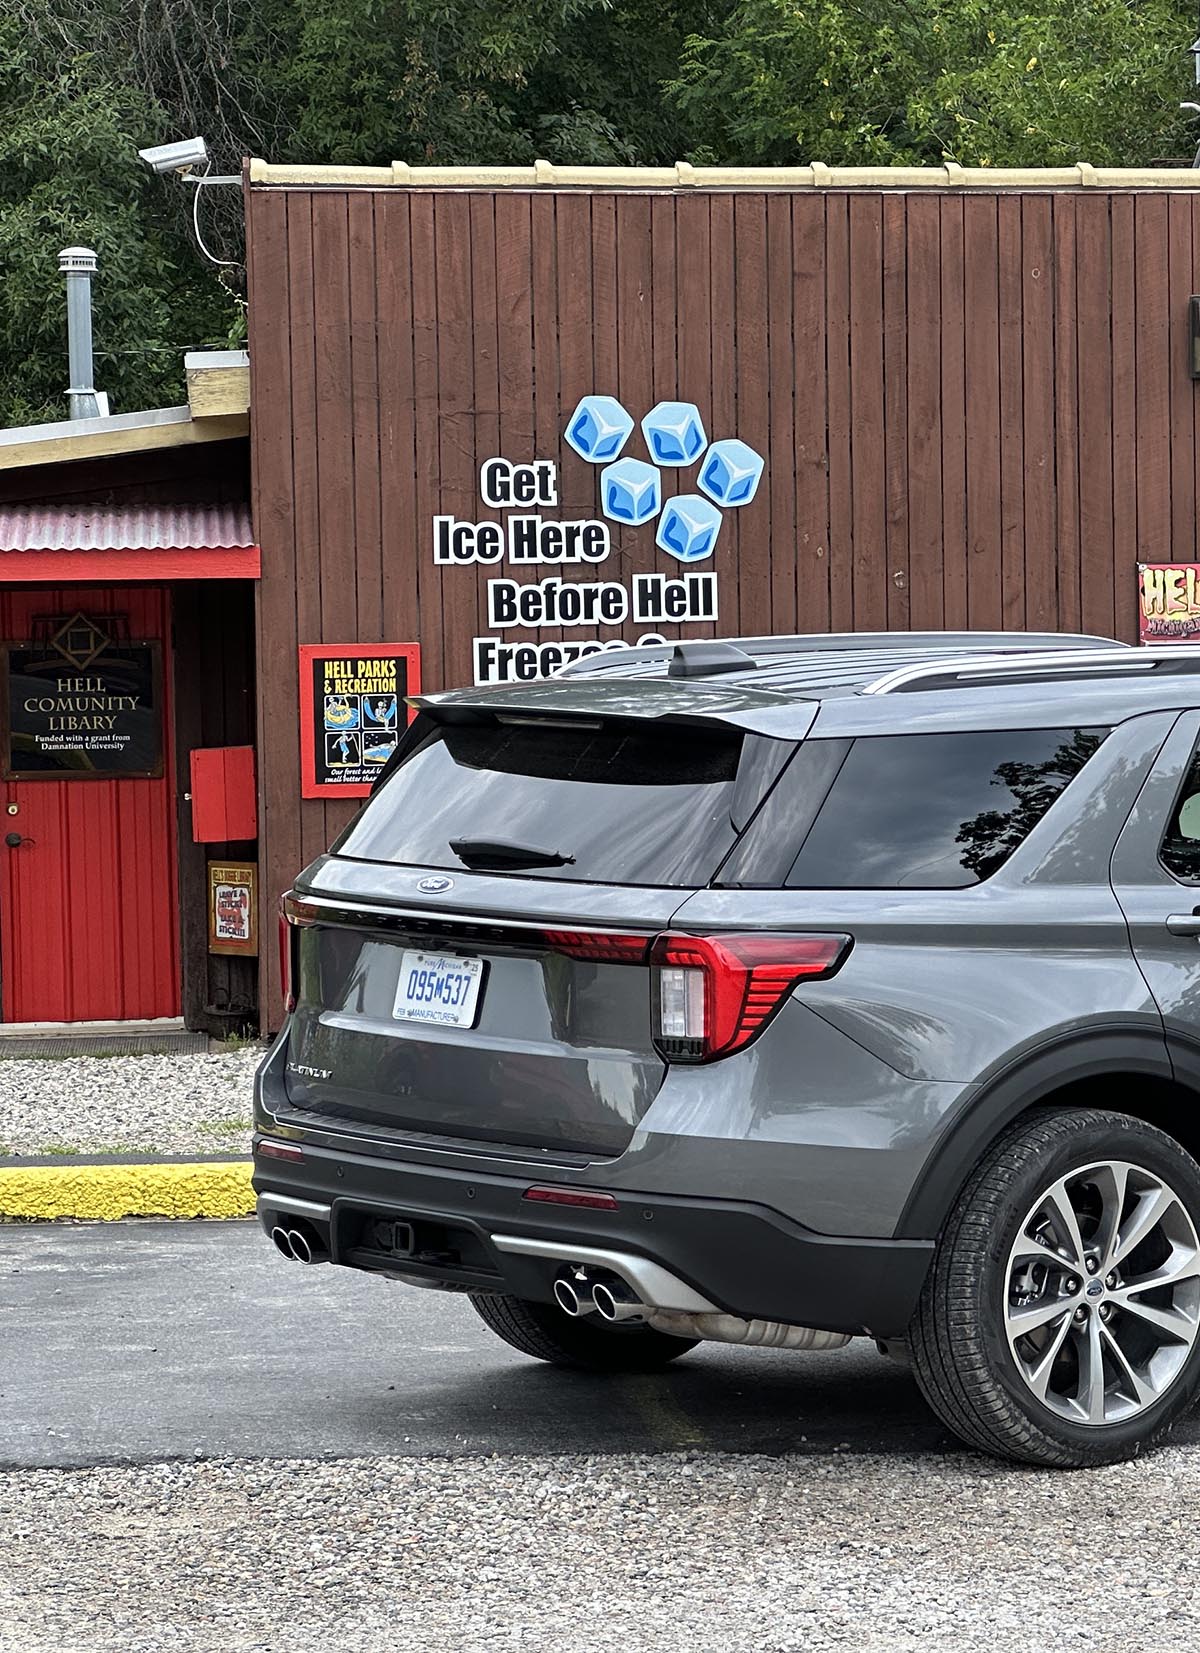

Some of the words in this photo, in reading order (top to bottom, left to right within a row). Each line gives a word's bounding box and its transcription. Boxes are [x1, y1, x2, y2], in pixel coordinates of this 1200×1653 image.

[485, 461, 552, 502] Get
[438, 520, 500, 559] Ice
[512, 518, 606, 559] Here
[492, 580, 624, 623] Before
[637, 577, 714, 618] Hell
[324, 661, 354, 679] HELL
[357, 660, 397, 678] PARKS
[57, 678, 106, 692] HELL
[323, 679, 332, 694] &
[335, 678, 397, 693] RECREATION
[24, 696, 140, 712] COMUNITY
[48, 715, 117, 731] LIBARY
[35, 735, 64, 743] Funded
[90, 735, 111, 743] grant
[41, 742, 84, 750] Damnation
[85, 741, 125, 750] University
[406, 969, 472, 1006] 095M537
